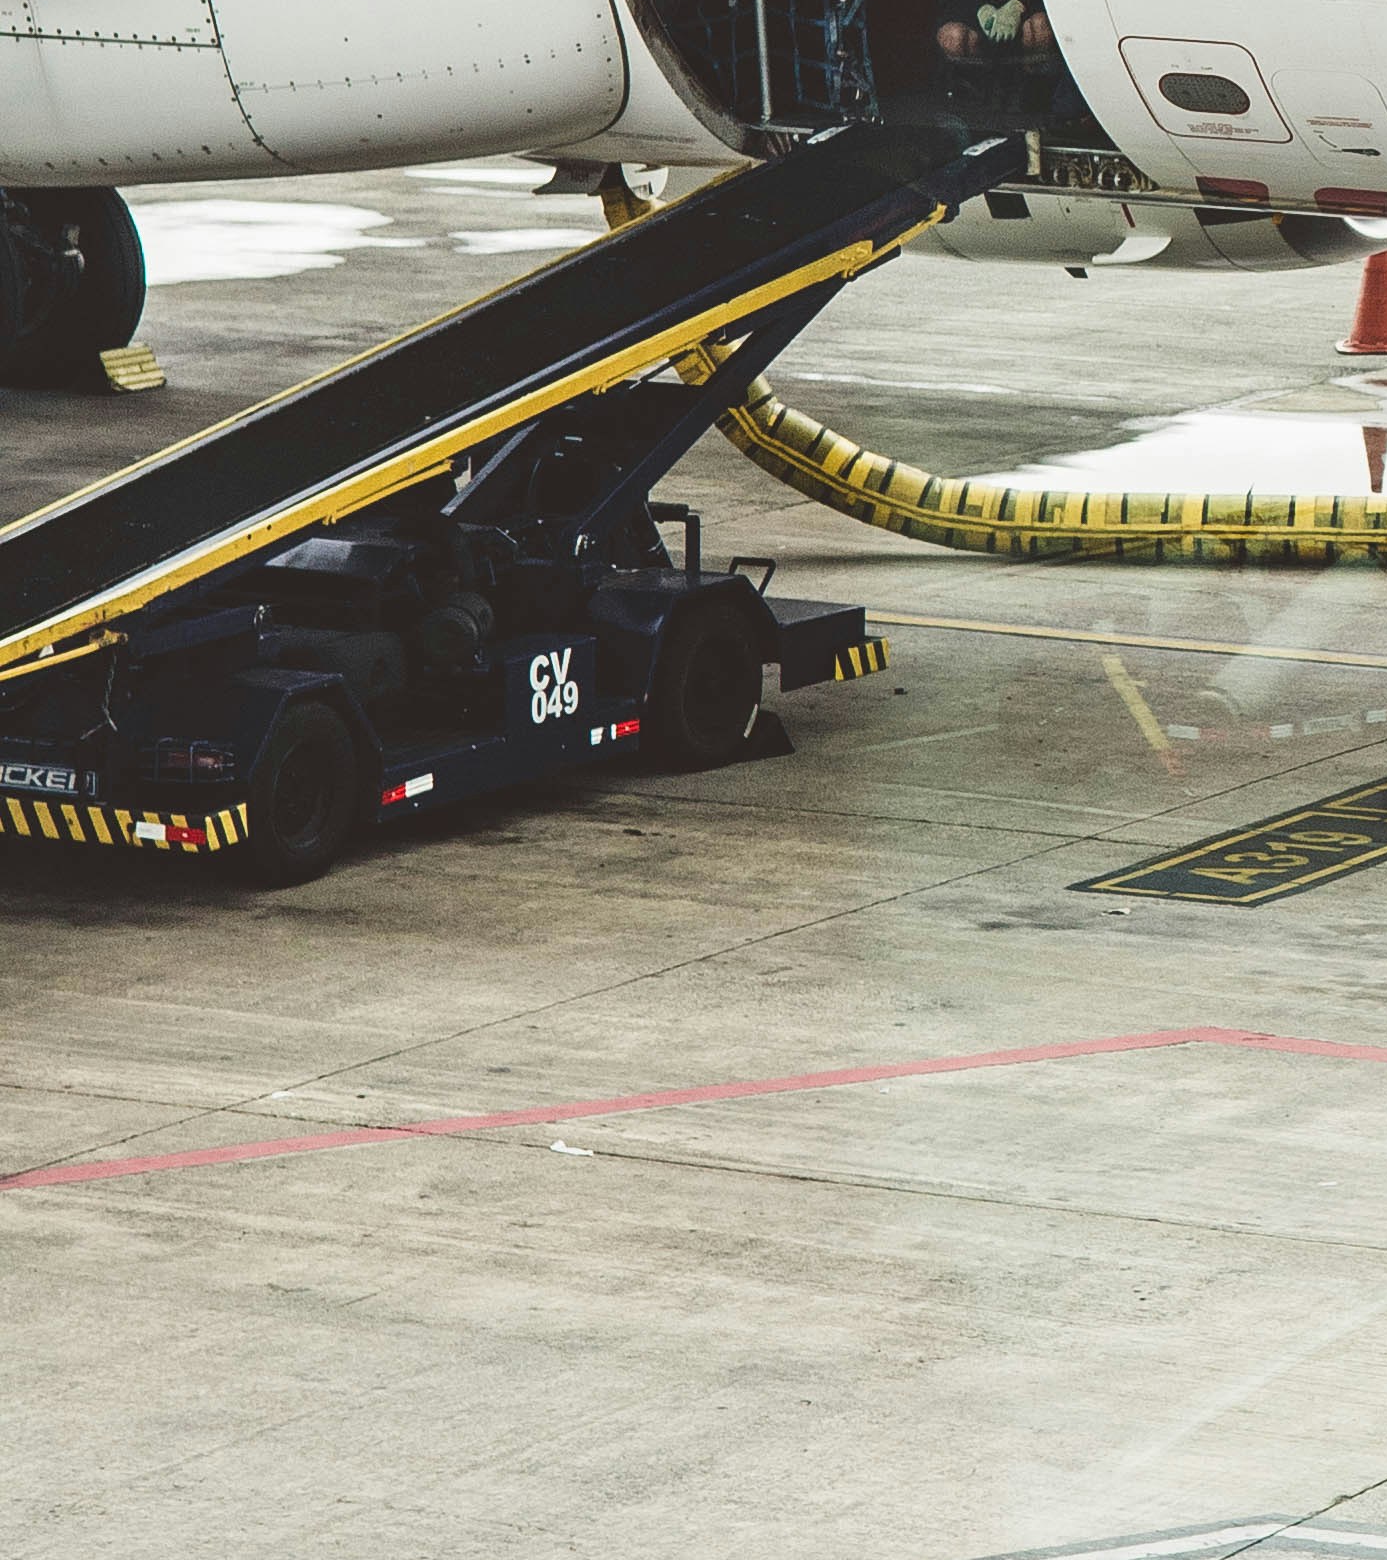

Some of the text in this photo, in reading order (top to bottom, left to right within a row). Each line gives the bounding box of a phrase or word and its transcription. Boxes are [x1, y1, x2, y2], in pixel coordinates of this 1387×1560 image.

[529, 647, 572, 691] CV
[531, 680, 579, 724] 049
[1190, 830, 1373, 885] A319
